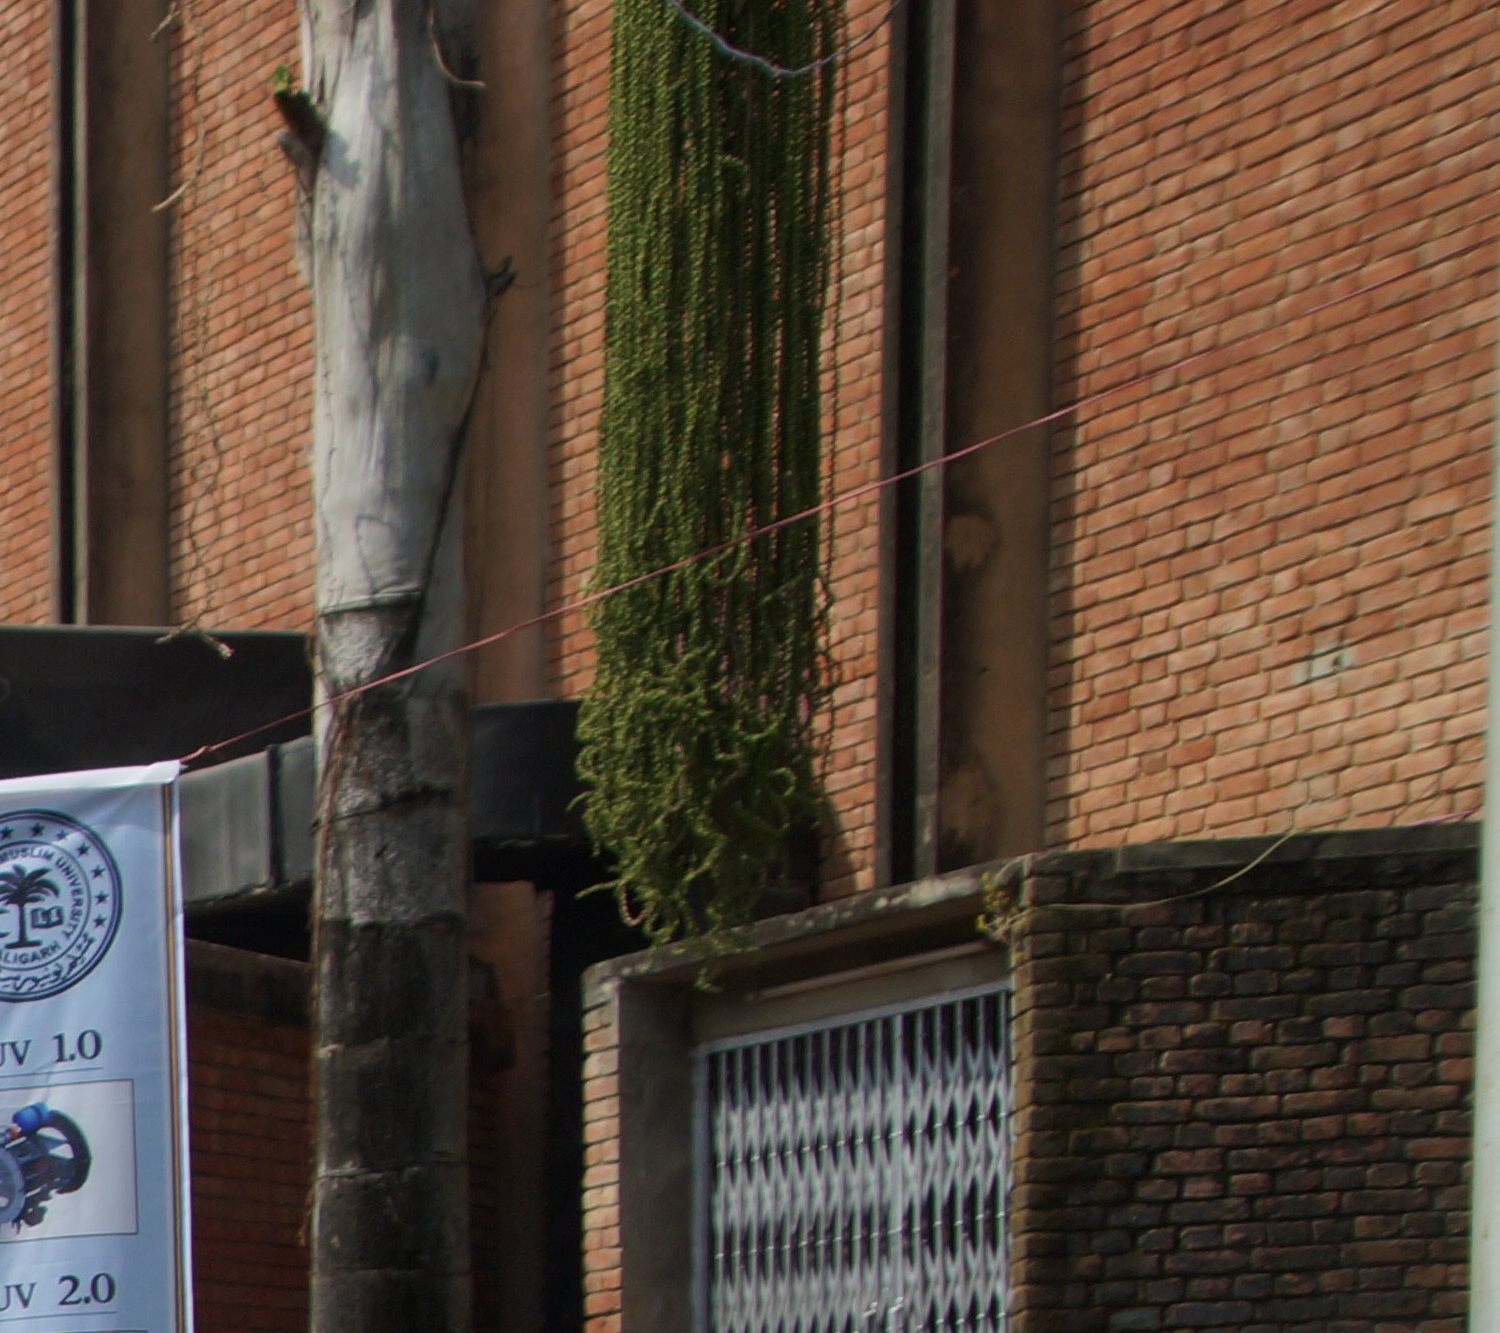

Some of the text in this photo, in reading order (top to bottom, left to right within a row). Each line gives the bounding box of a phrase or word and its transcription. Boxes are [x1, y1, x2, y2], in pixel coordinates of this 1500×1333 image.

[55, 857, 85, 940] UNIVERSITY
[52, 1029, 104, 1065] 1.0
[57, 1271, 118, 1309] 2.0
